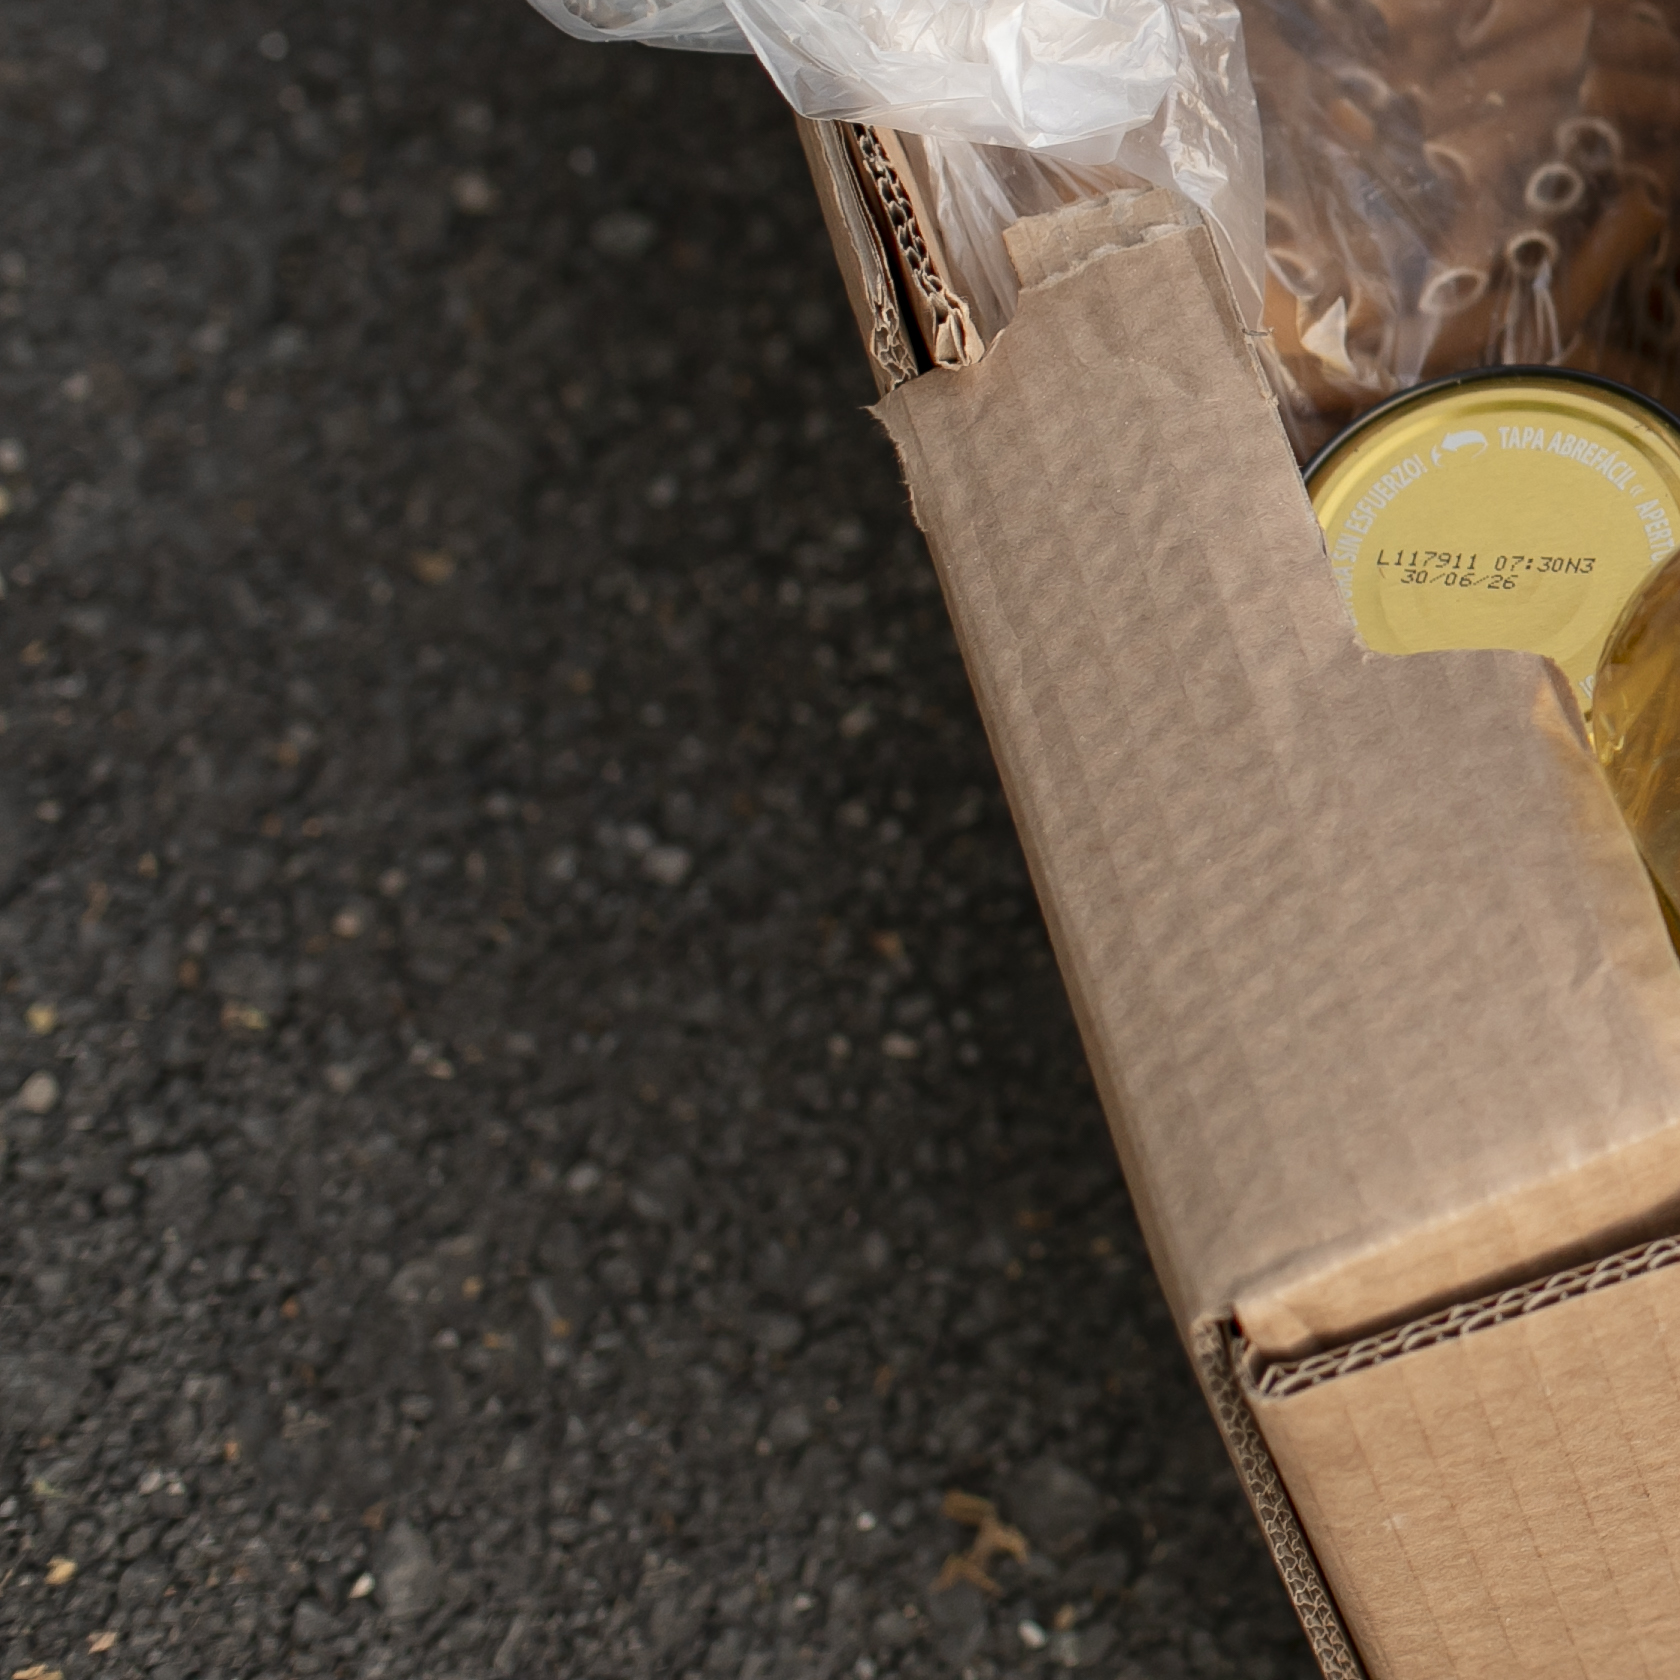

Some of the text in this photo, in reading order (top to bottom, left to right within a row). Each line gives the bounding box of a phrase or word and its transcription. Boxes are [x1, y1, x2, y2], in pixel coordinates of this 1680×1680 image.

[1498, 426, 1545, 451] TAPA
[1547, 431, 1637, 492] ABREFÁCIL
[1343, 453, 1428, 536] ESFUERZO!
[1332, 532, 1363, 564] SIN
[1376, 549, 1597, 574] L117911 07:30N3
[1400, 568, 1519, 590] 30/06/26
